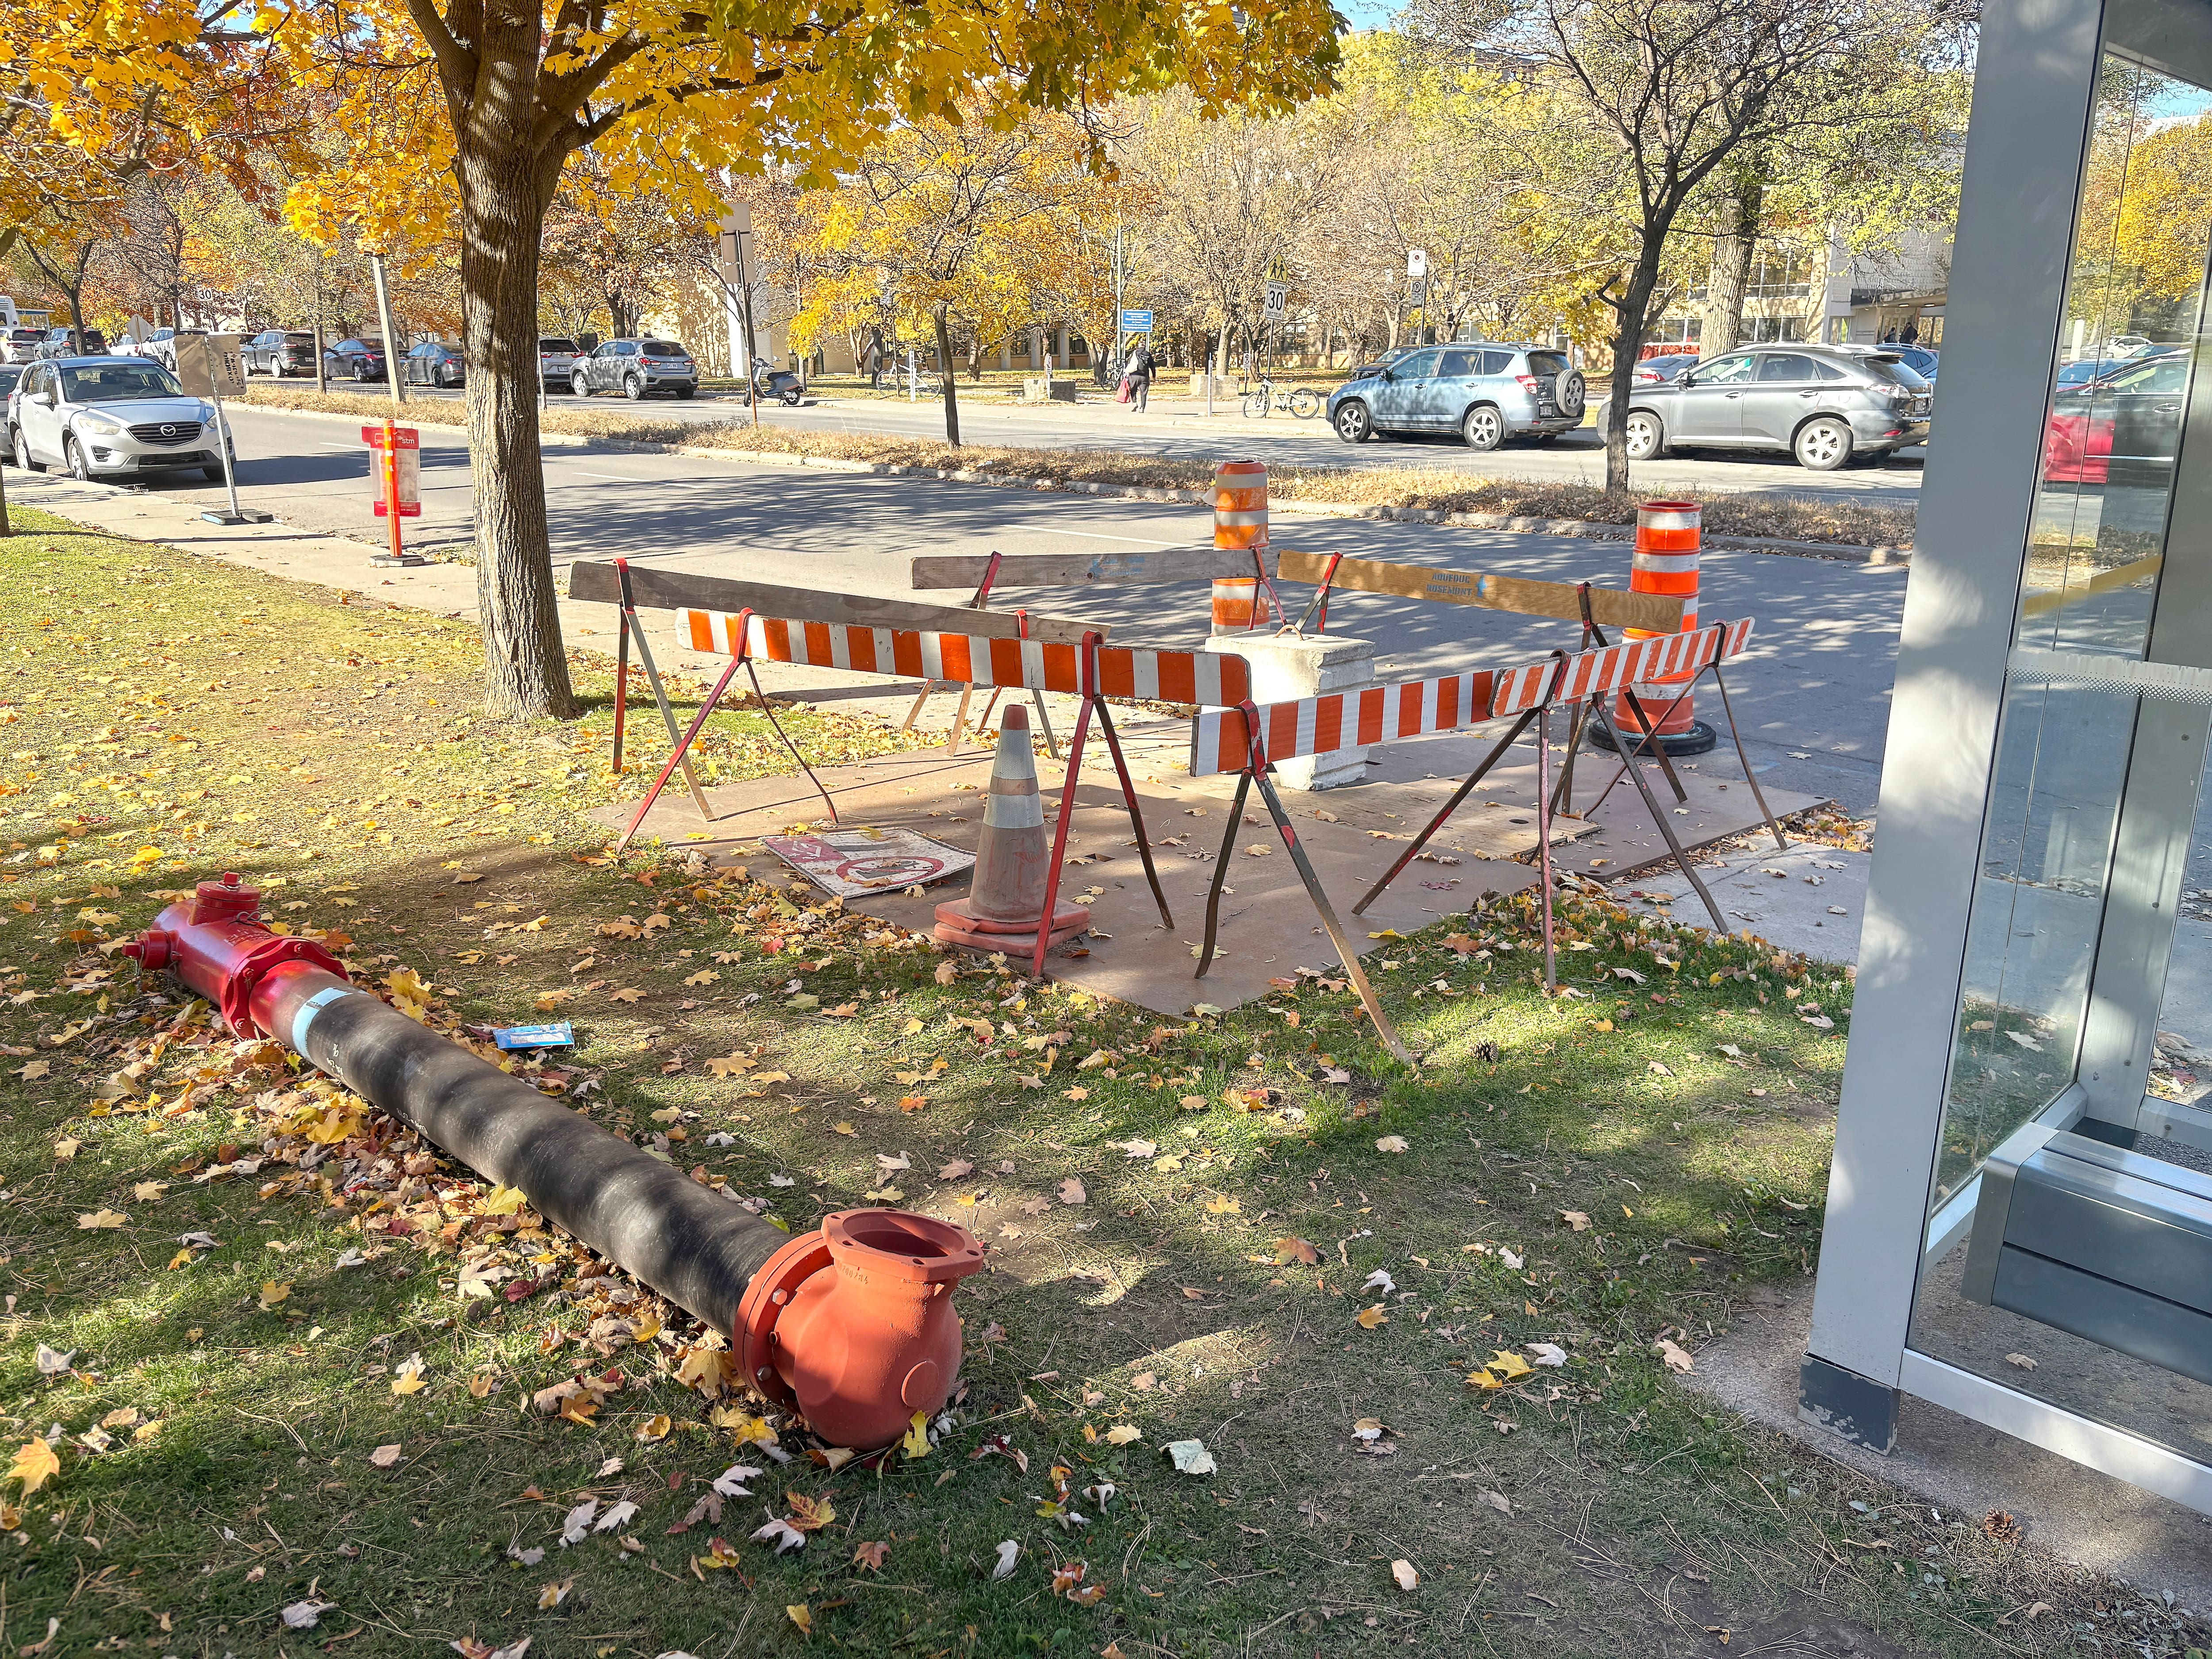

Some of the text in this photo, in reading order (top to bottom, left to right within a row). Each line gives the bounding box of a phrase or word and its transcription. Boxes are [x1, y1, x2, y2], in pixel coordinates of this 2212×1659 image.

[199, 290, 211, 299] 30
[1268, 290, 1283, 311] 30
[1432, 573, 1470, 583] AQUEDUC
[1426, 583, 1472, 595] ROSEMONT
